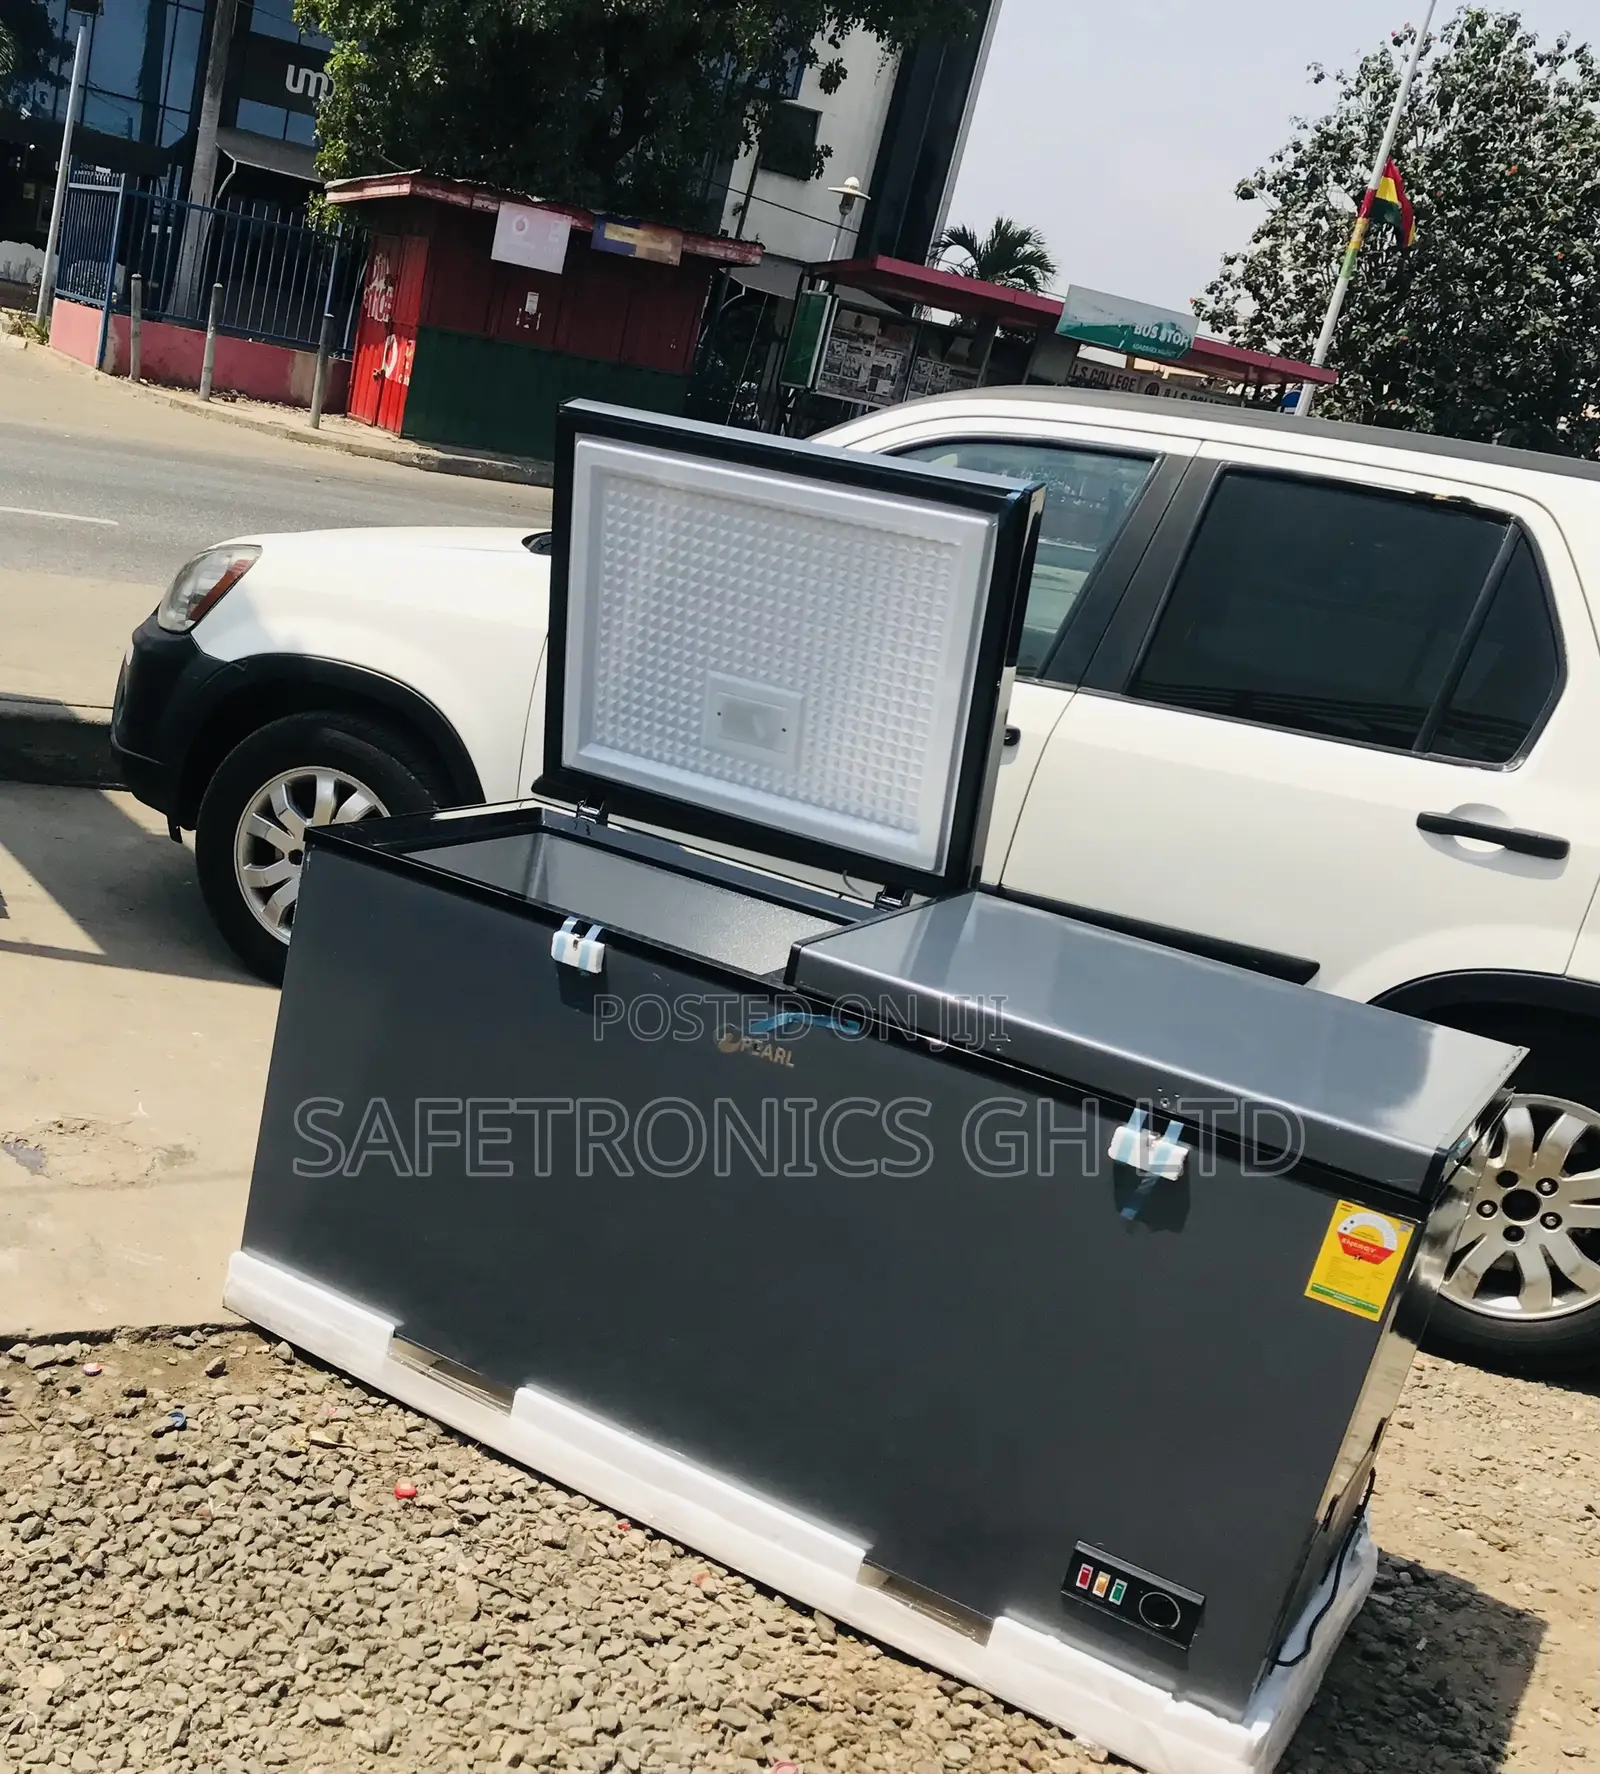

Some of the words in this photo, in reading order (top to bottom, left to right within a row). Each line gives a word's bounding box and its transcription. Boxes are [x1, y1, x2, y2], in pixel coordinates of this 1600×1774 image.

[1133, 323, 1158, 340] BUS
[1159, 328, 1191, 347] STOP
[1090, 369, 1137, 393] COLLEGE
[740, 1035, 795, 1068] PEARL
[1341, 1237, 1377, 1254] ENERGY
